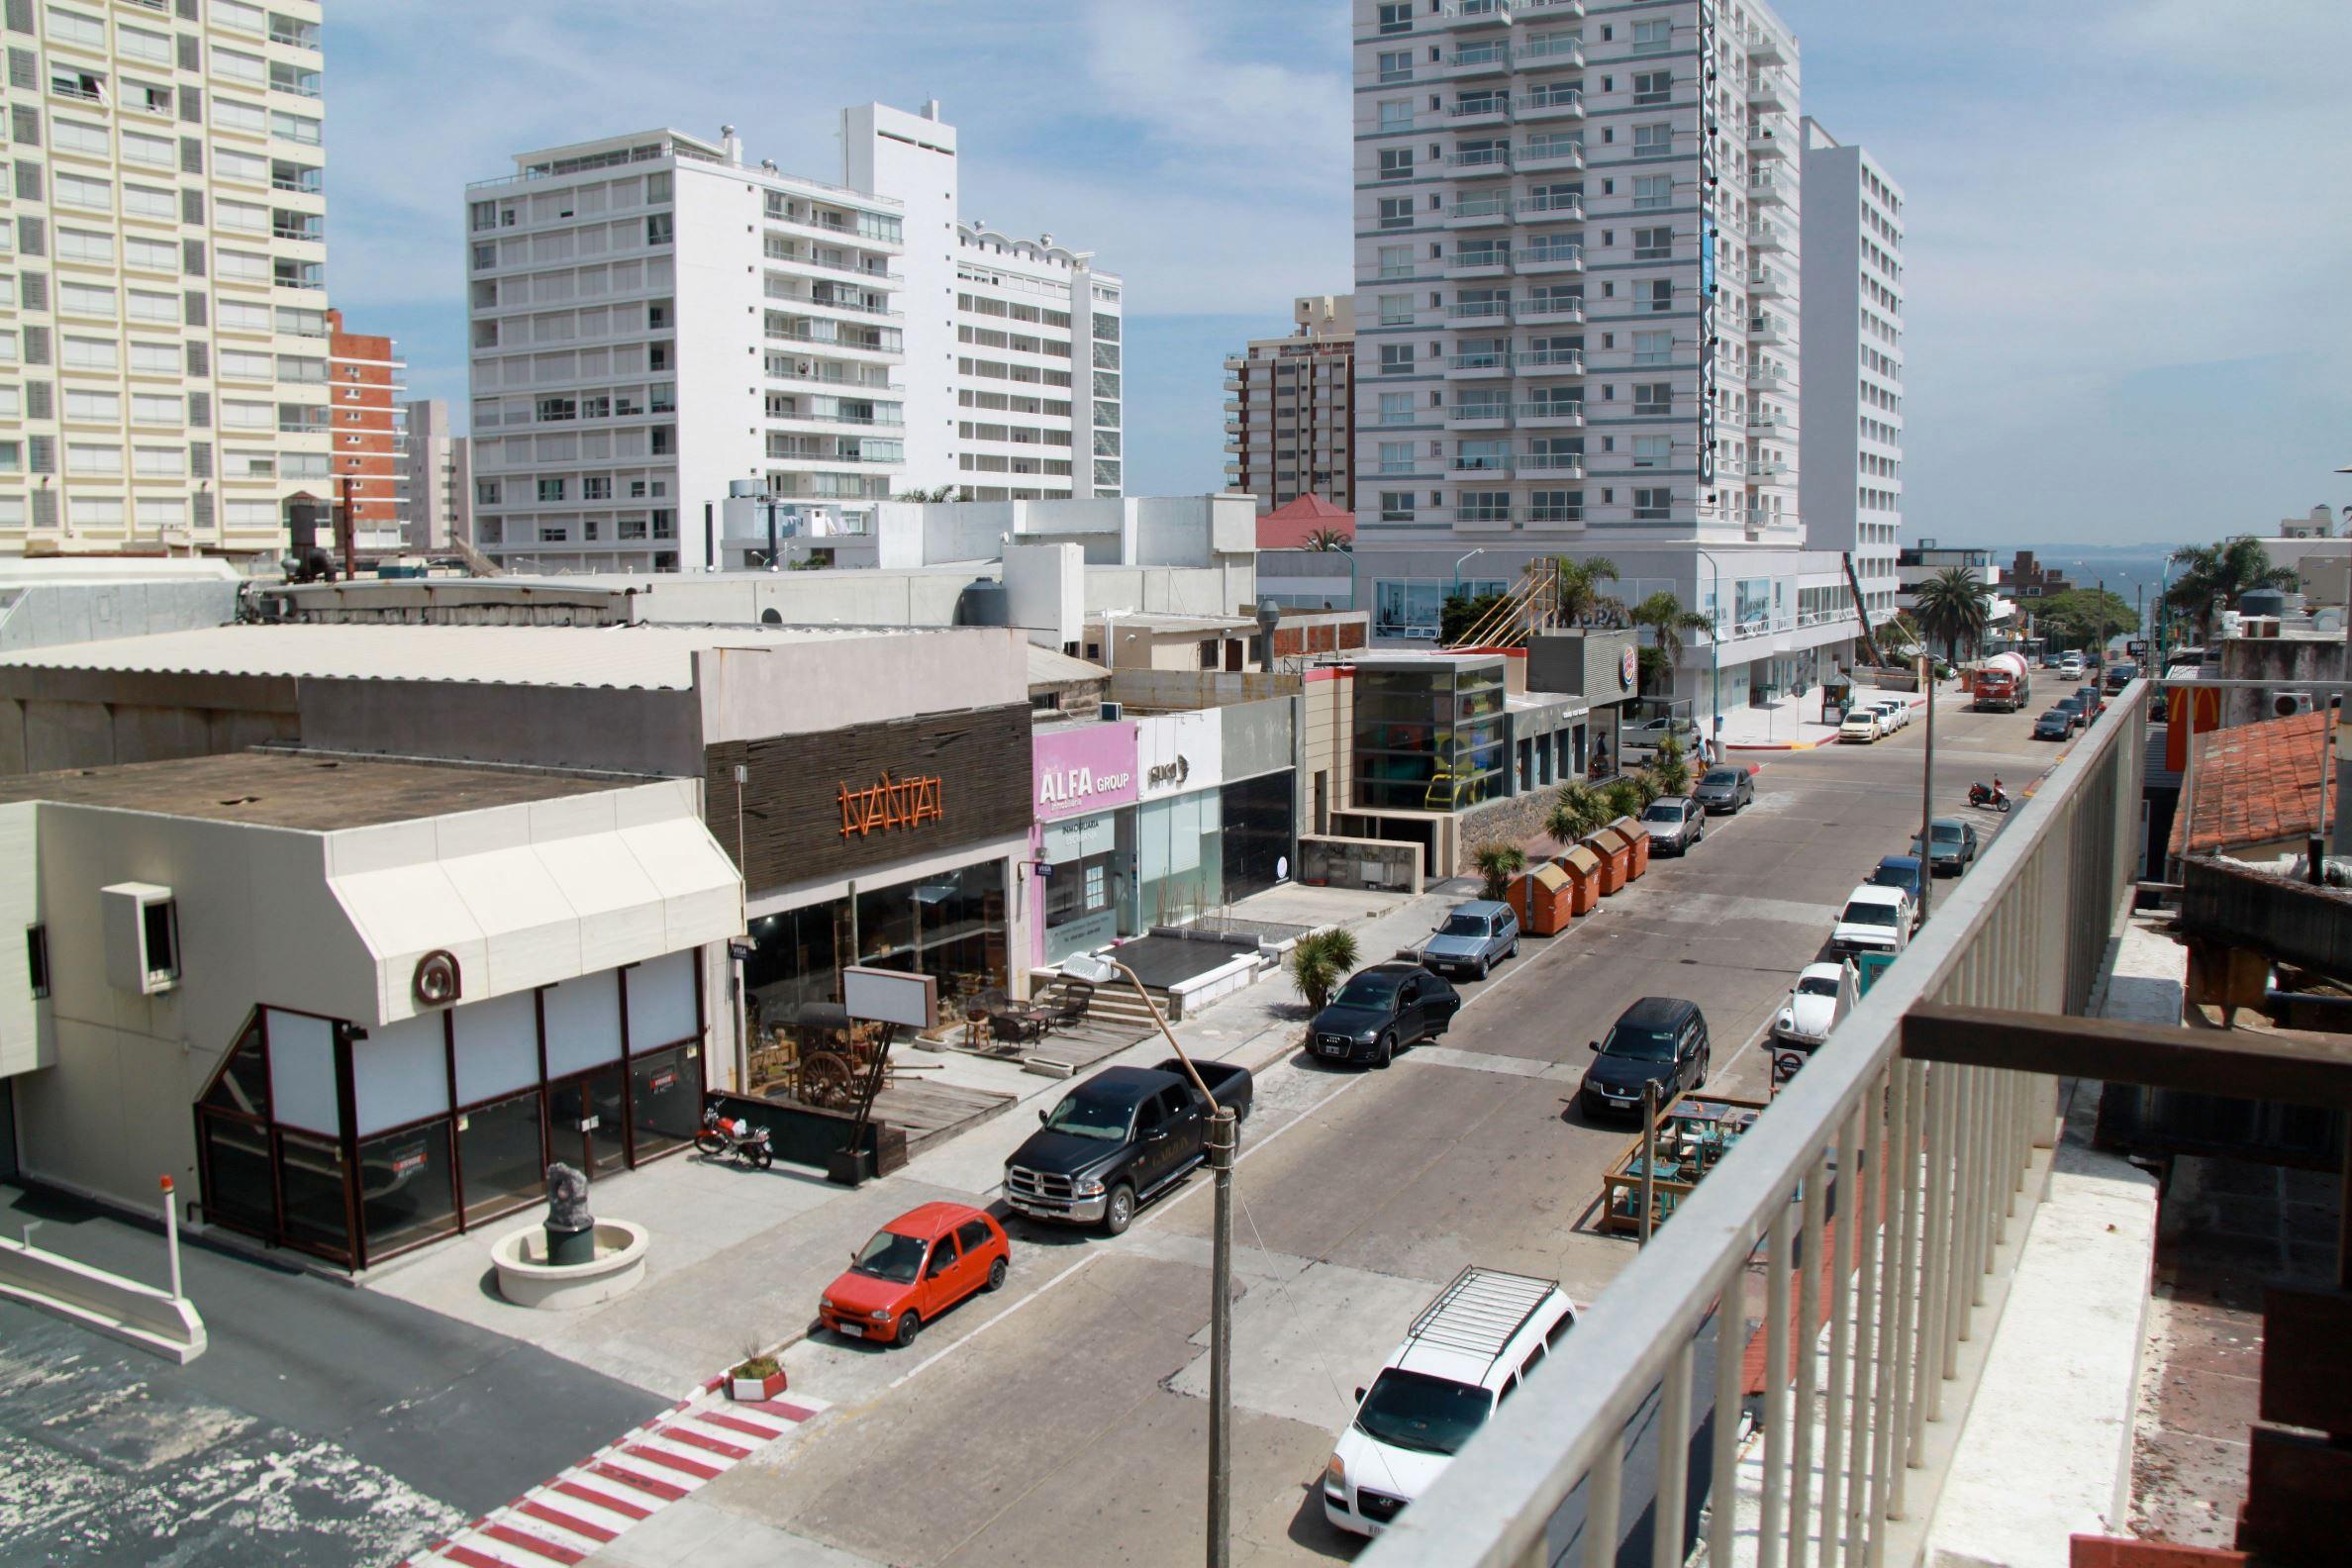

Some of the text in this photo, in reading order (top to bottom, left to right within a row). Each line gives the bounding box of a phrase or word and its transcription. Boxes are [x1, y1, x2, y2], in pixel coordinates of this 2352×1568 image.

[1704, 305, 1713, 478] OCUPA YA
[1039, 767, 1129, 804] ALFA GROUP
